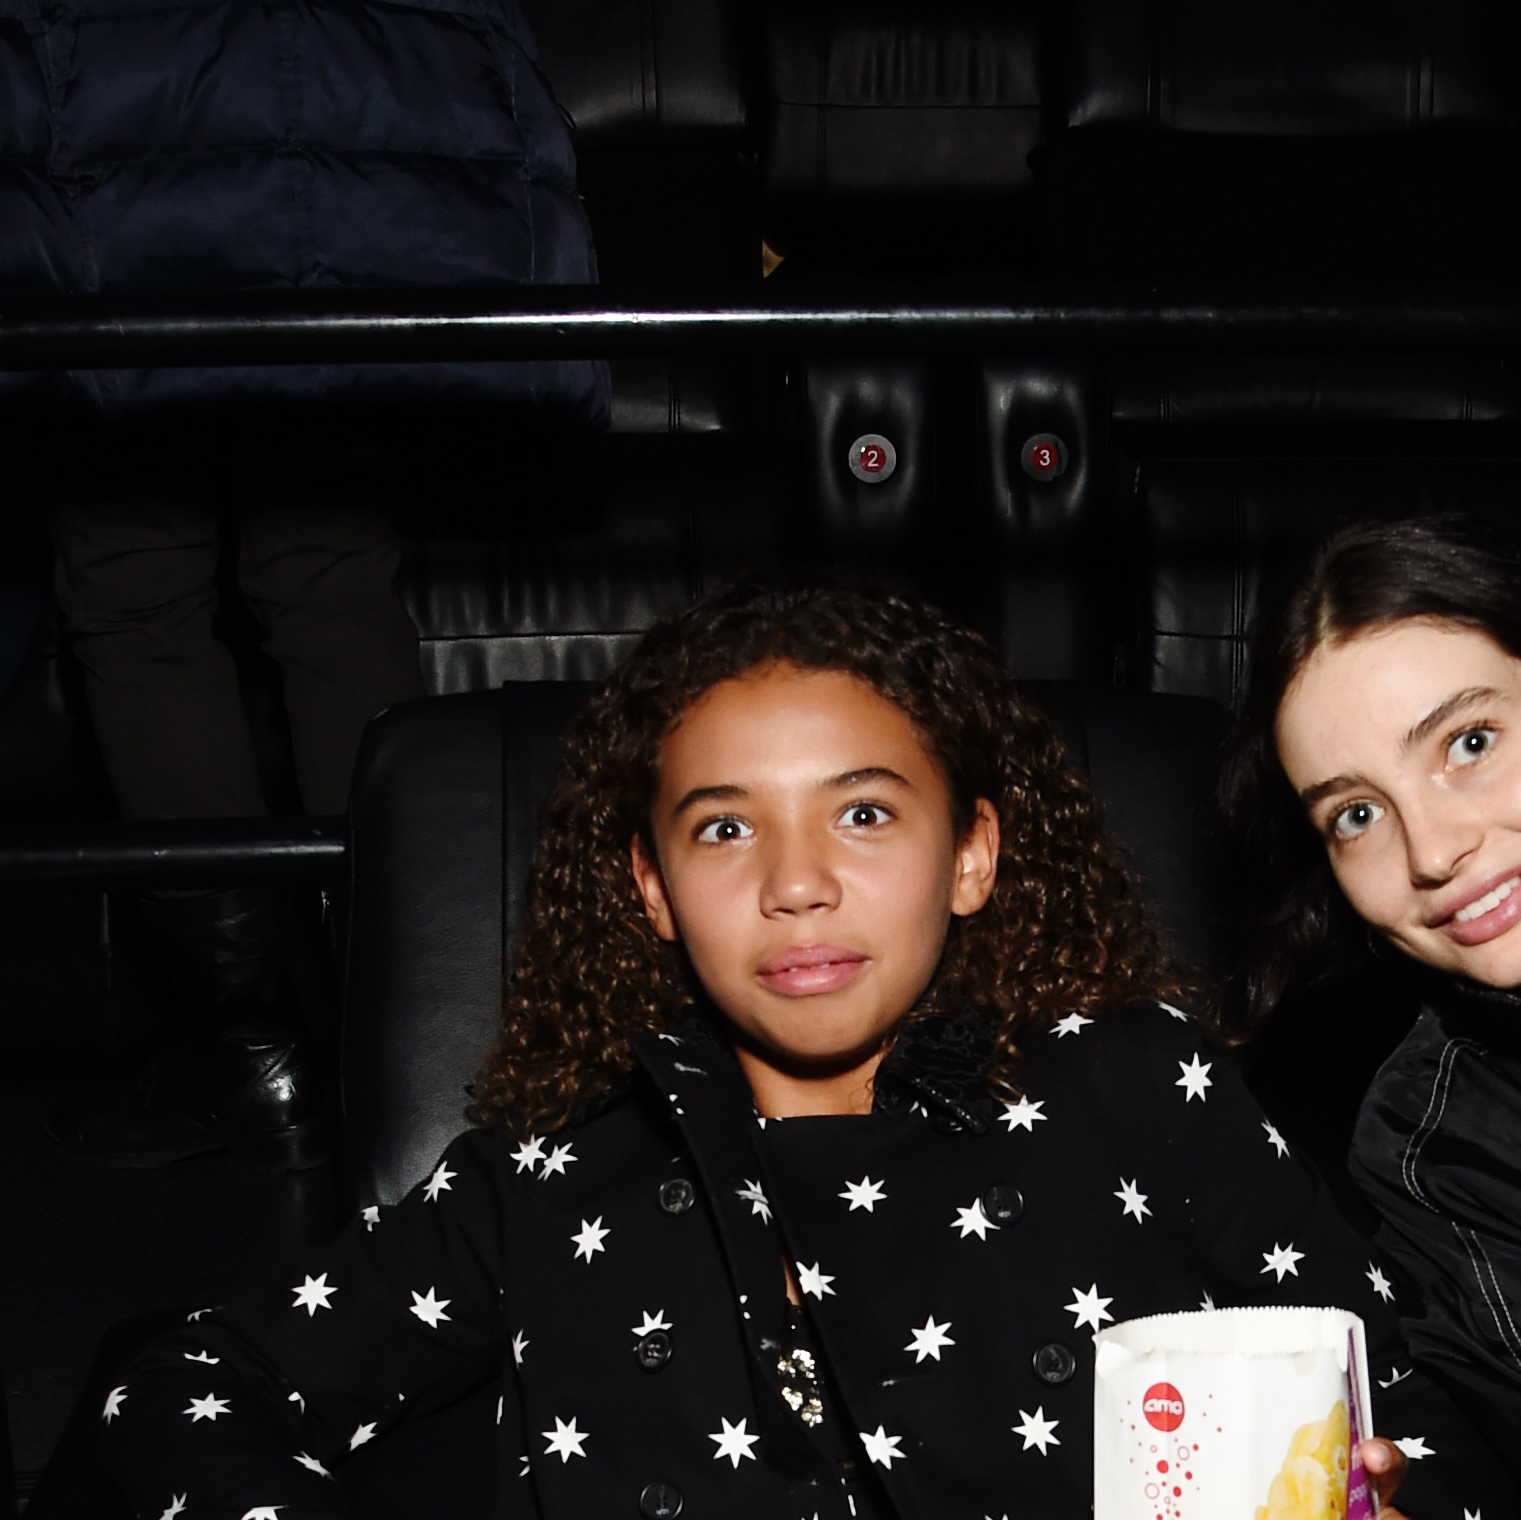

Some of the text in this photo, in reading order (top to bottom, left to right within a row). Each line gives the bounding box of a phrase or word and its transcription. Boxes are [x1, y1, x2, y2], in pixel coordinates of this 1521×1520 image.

[866, 450, 879, 467] 2
[1039, 449, 1051, 466] 3
[1144, 1398, 1183, 1416] amc
